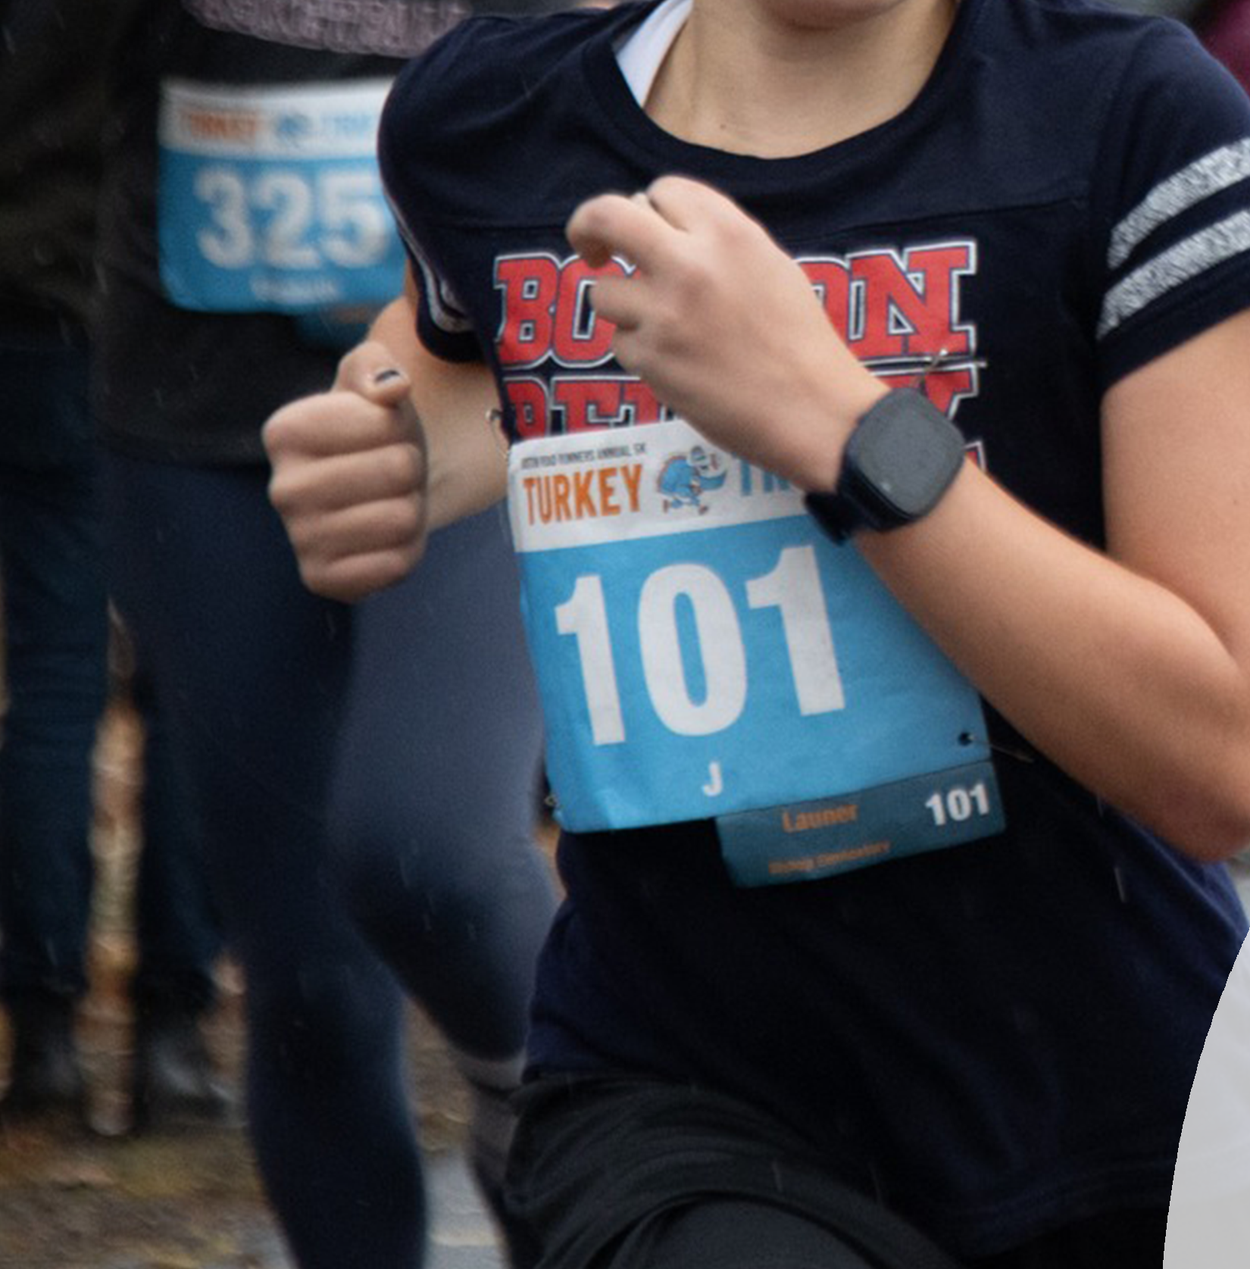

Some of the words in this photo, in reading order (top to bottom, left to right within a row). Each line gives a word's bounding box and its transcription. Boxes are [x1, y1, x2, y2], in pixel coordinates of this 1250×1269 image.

[195, 165, 390, 271] 325
[493, 240, 978, 369] BON
[522, 463, 643, 526] TURKEY
[554, 545, 846, 746] 101
[701, 761, 723, 797] J
[925, 782, 991, 827] 101
